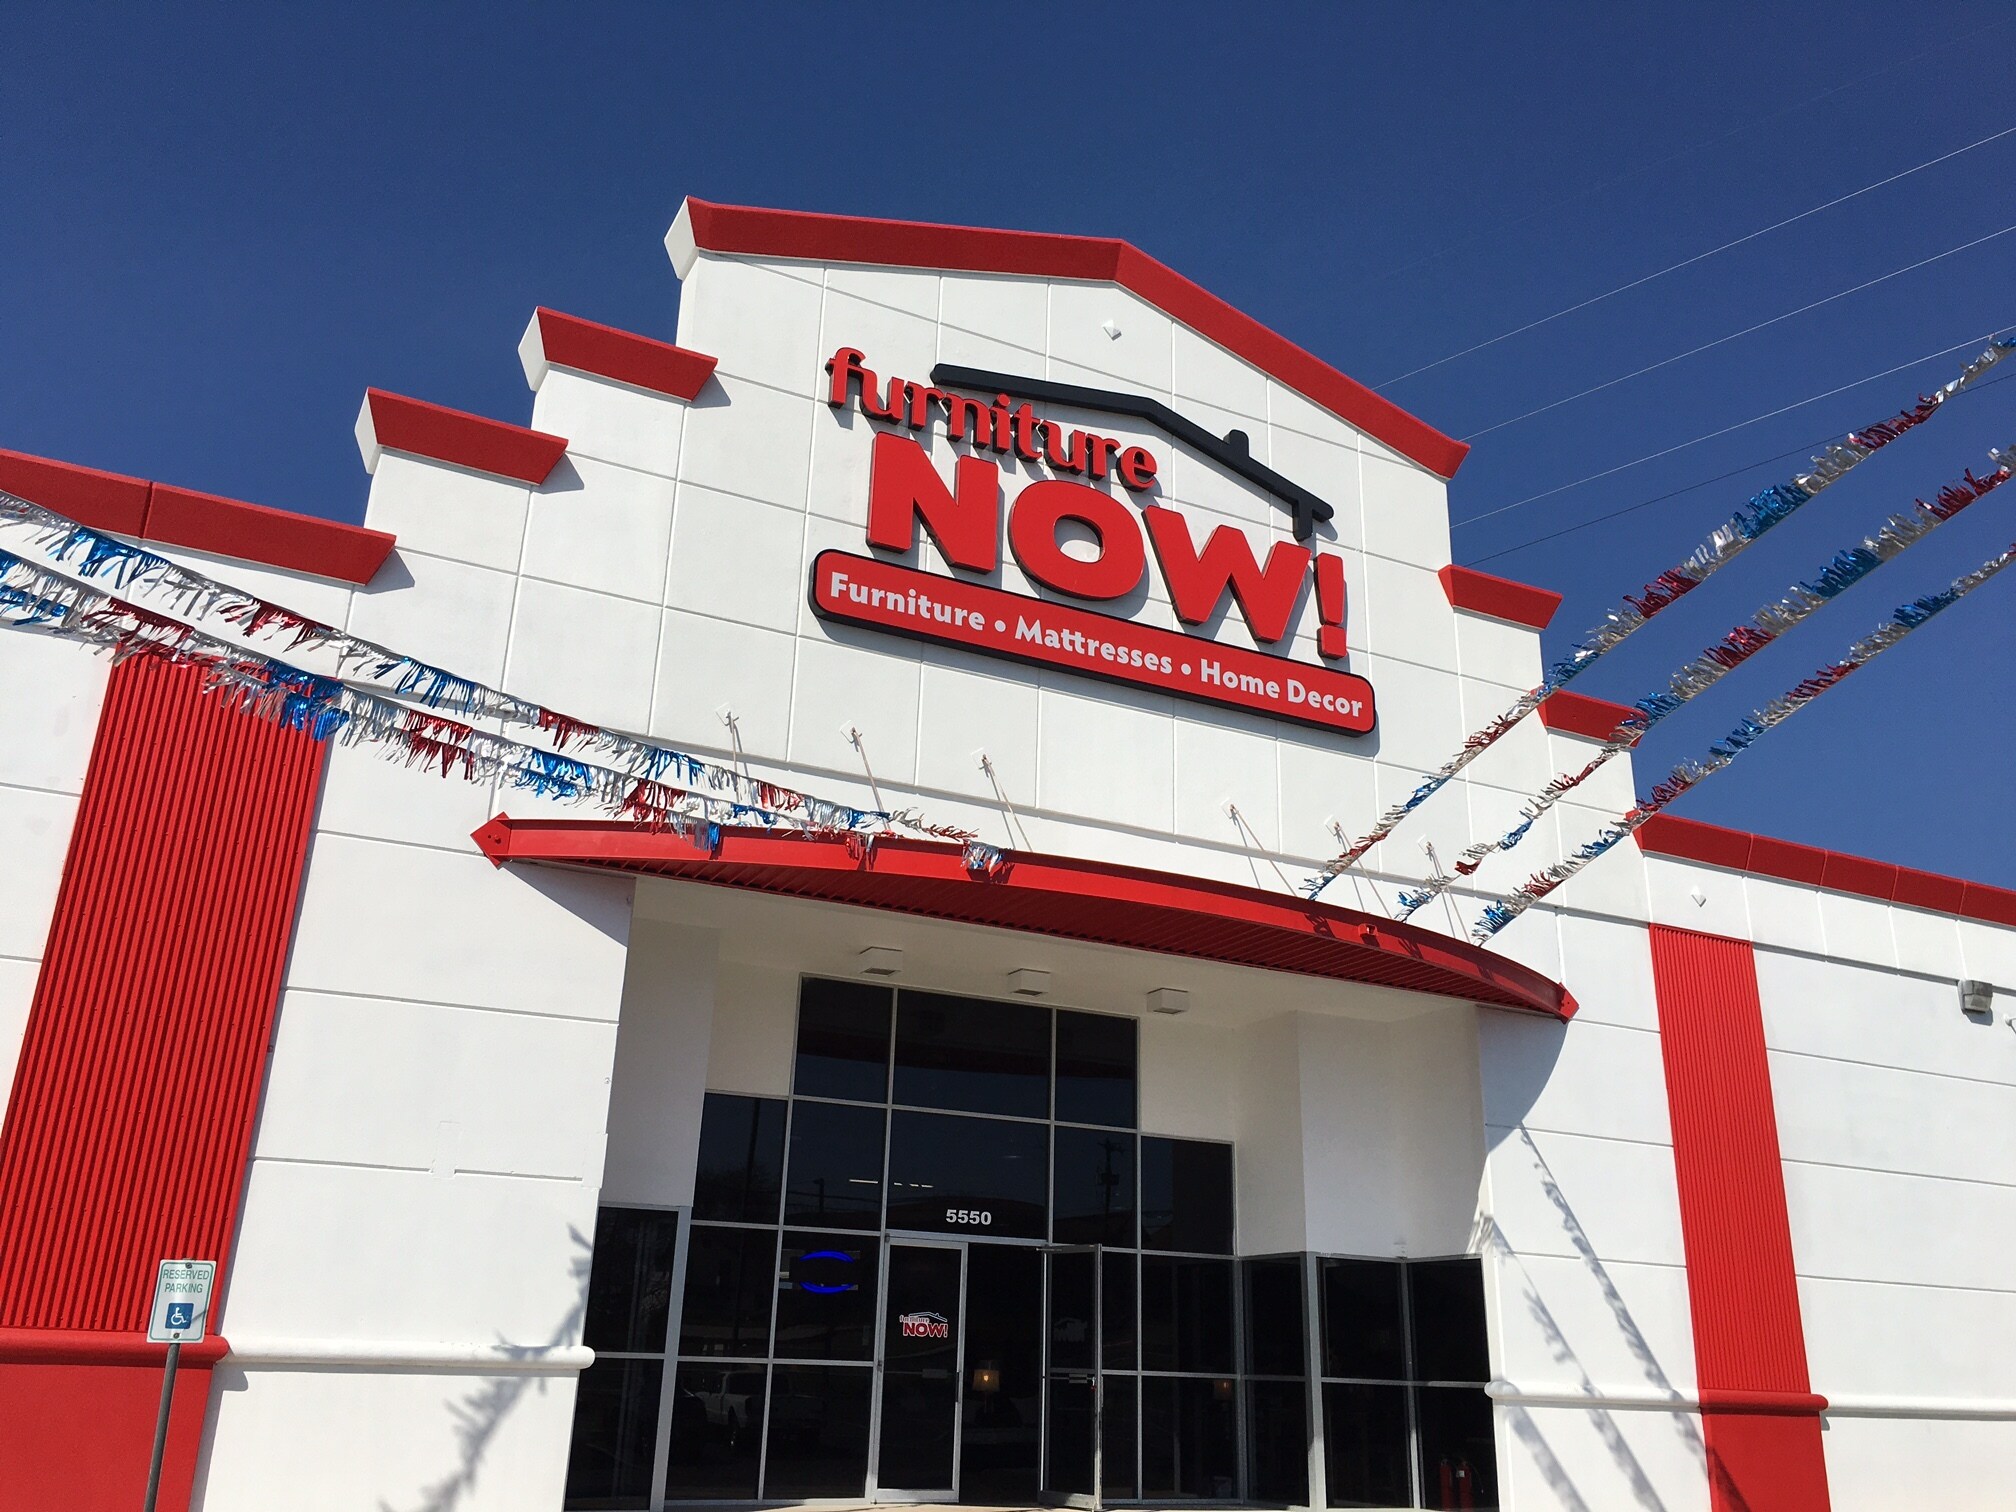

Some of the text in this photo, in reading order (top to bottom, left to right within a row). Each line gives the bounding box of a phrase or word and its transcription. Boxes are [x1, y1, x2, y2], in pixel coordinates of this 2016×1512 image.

[825, 347, 1157, 491] furniture
[866, 431, 1347, 660] NOW!
[830, 571, 1362, 717] Furniture Mattresses Home Decor
[945, 1209, 991, 1225] 5550
[163, 1269, 210, 1280] RESERVED
[165, 1283, 203, 1293] PARKING
[903, 1321, 948, 1338] NOW!
